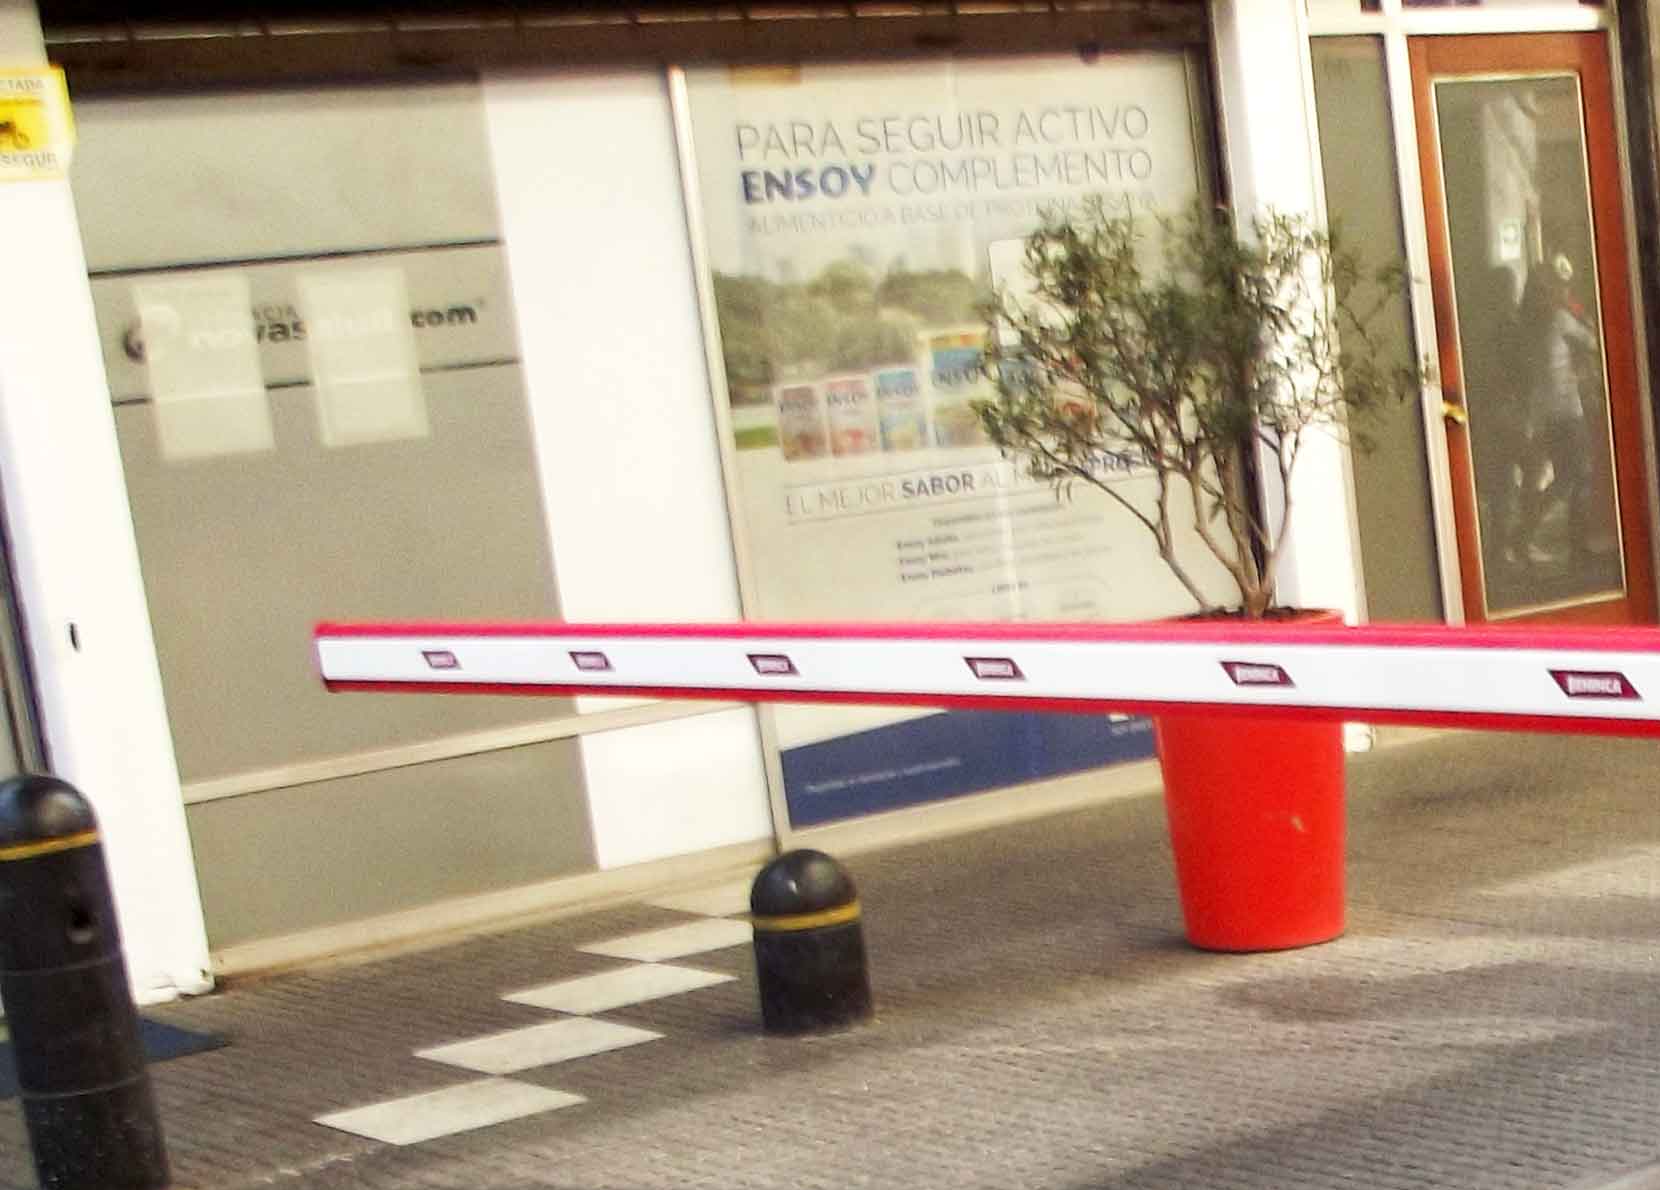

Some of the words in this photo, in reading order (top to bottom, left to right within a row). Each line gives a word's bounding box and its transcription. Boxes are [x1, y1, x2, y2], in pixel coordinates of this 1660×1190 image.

[735, 121, 847, 161] PARA
[855, 111, 1000, 156] SEGUIR
[1014, 104, 1149, 145] ACTIVO
[740, 163, 877, 205] ENSOY
[887, 149, 1153, 197] COMPLEMENTO
[817, 483, 897, 511] MEJOR
[900, 472, 976, 500] SABOR
